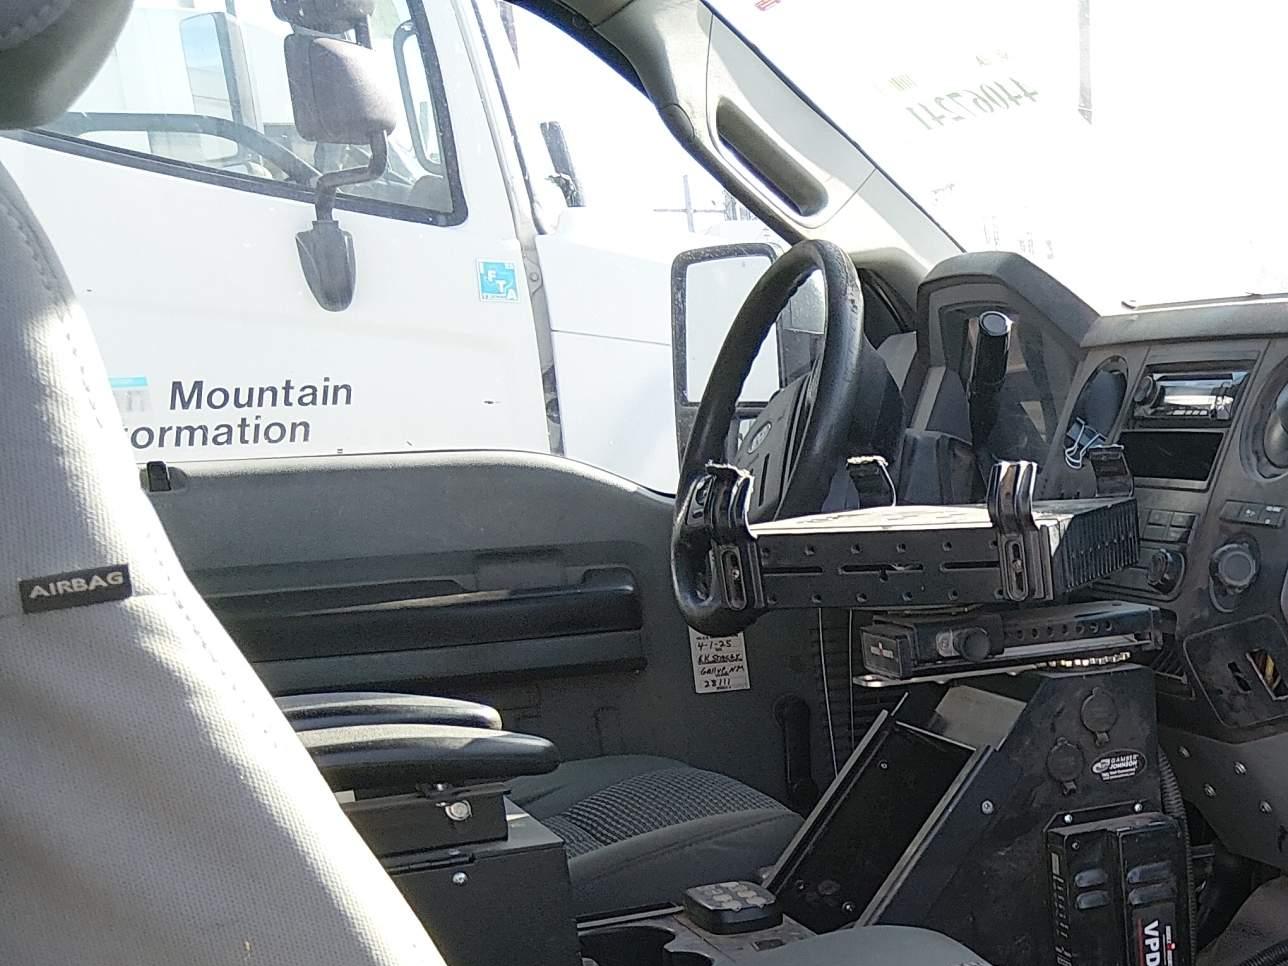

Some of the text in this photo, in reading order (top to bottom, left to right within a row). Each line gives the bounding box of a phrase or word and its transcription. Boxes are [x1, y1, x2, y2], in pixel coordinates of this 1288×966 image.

[169, 376, 353, 411] Mountain
[124, 415, 311, 450] ormation
[29, 571, 124, 599] AIRBAG
